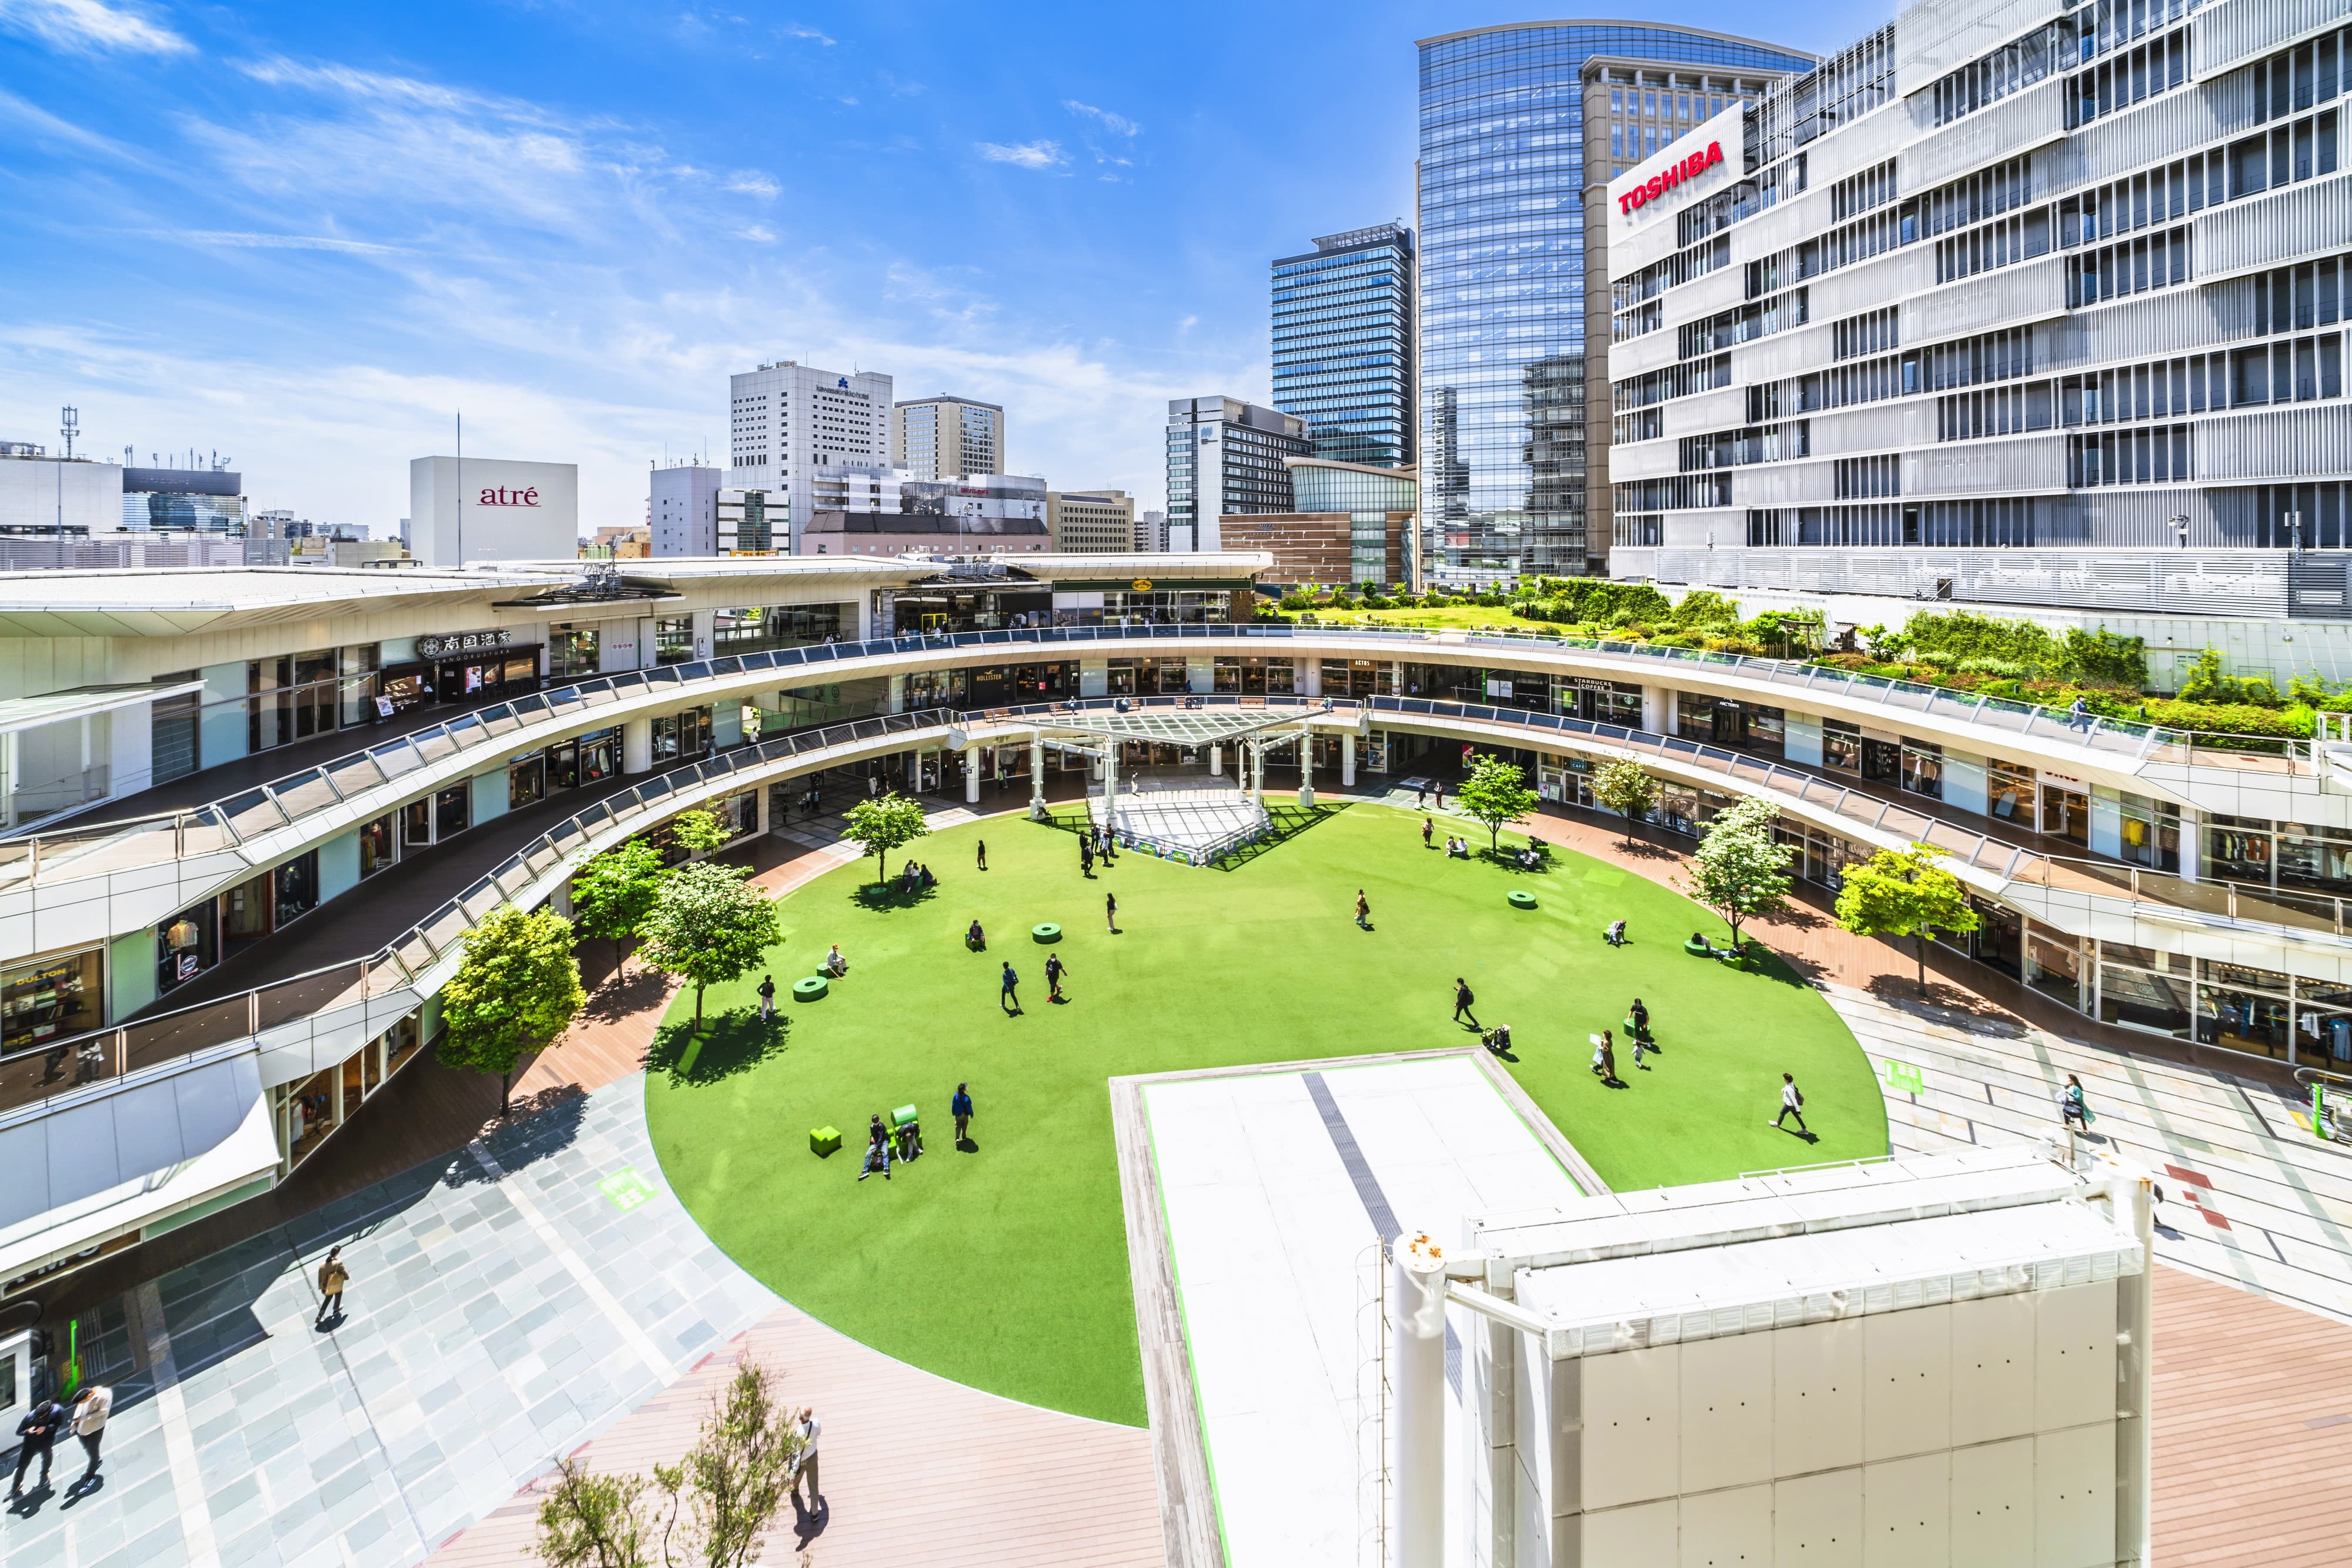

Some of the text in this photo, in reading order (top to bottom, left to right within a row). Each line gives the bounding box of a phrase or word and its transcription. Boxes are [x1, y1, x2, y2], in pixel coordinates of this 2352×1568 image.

[1618, 141, 1723, 215] TOSHIBA
[816, 384, 869, 400] kawasaki nikko hotel
[480, 485, 539, 506] atré
[444, 631, 513, 651] 南国酒家
[435, 649, 510, 664] NANGOKUSYUKA
[1574, 678, 1612, 687] STARBUCKS
[16, 968, 66, 986] DULTON
